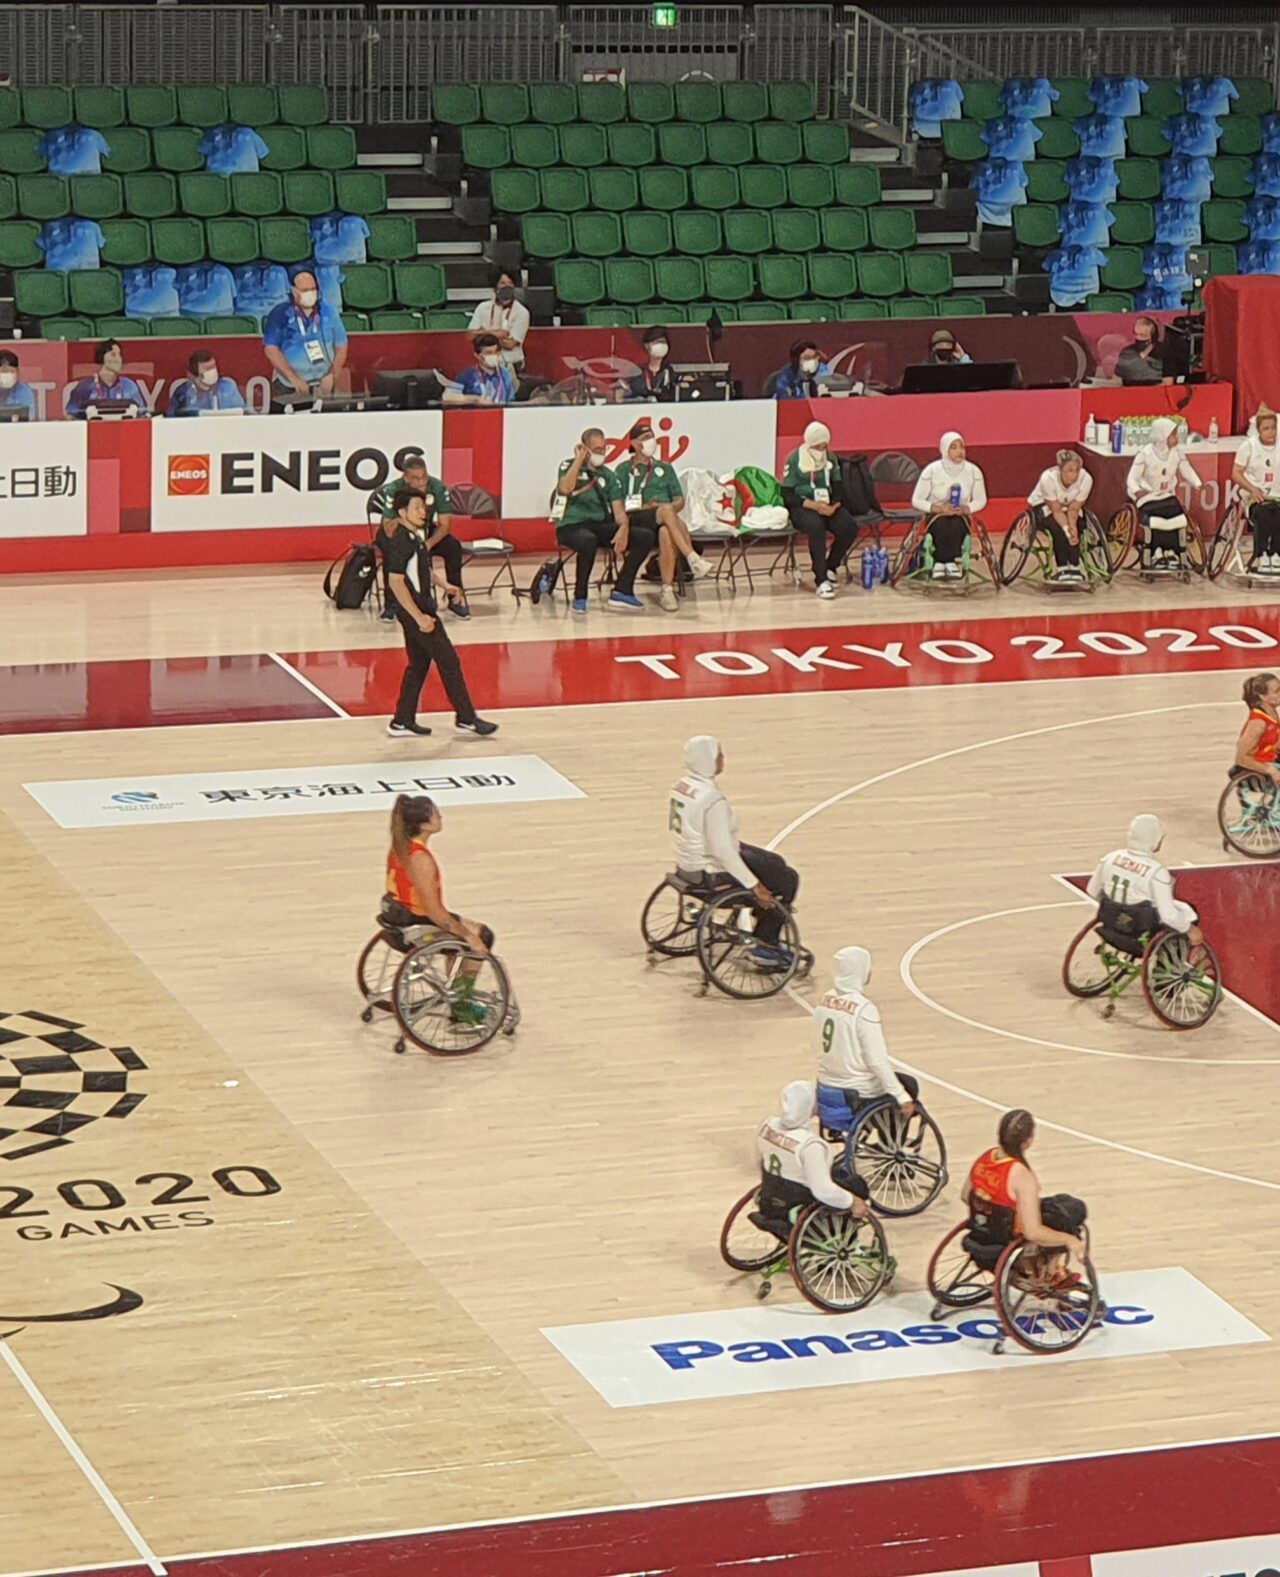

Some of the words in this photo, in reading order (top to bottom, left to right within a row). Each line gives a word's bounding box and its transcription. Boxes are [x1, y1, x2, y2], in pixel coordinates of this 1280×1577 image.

[170, 469, 207, 481] ENEOS
[615, 640, 994, 680] TOKYO
[1010, 625, 1279, 662] 2020
[200, 773, 517, 803] 東京海上日動
[1111, 874, 1130, 905] 11
[823, 1017, 835, 1053] 9
[16, 1211, 215, 1241] GAMES
